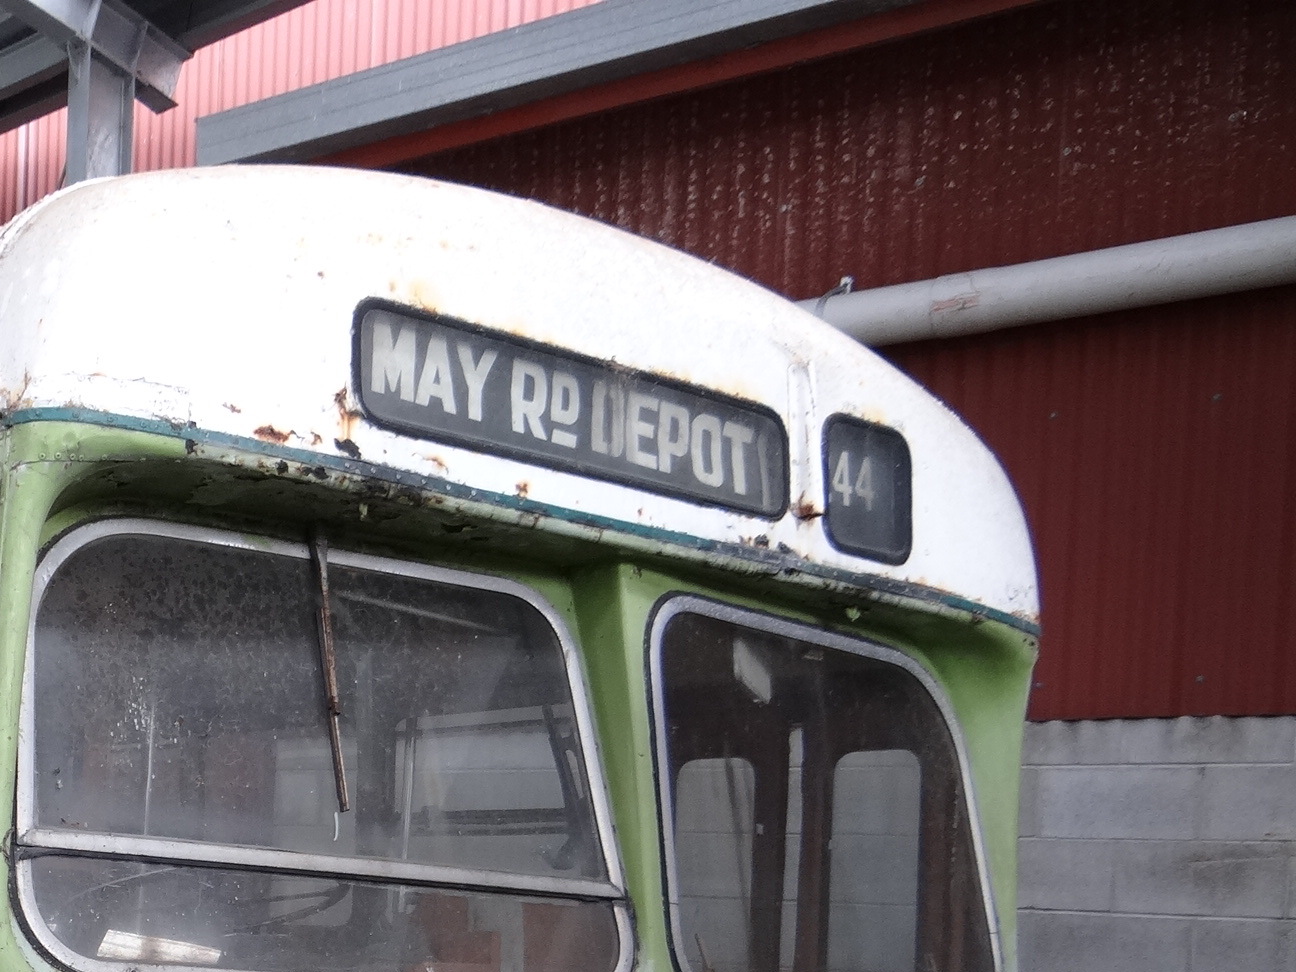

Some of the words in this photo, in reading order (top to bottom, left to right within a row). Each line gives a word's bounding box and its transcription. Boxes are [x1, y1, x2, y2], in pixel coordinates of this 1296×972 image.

[370, 321, 498, 422] MAY
[591, 379, 757, 496] DEPOT
[832, 449, 875, 510] 44
